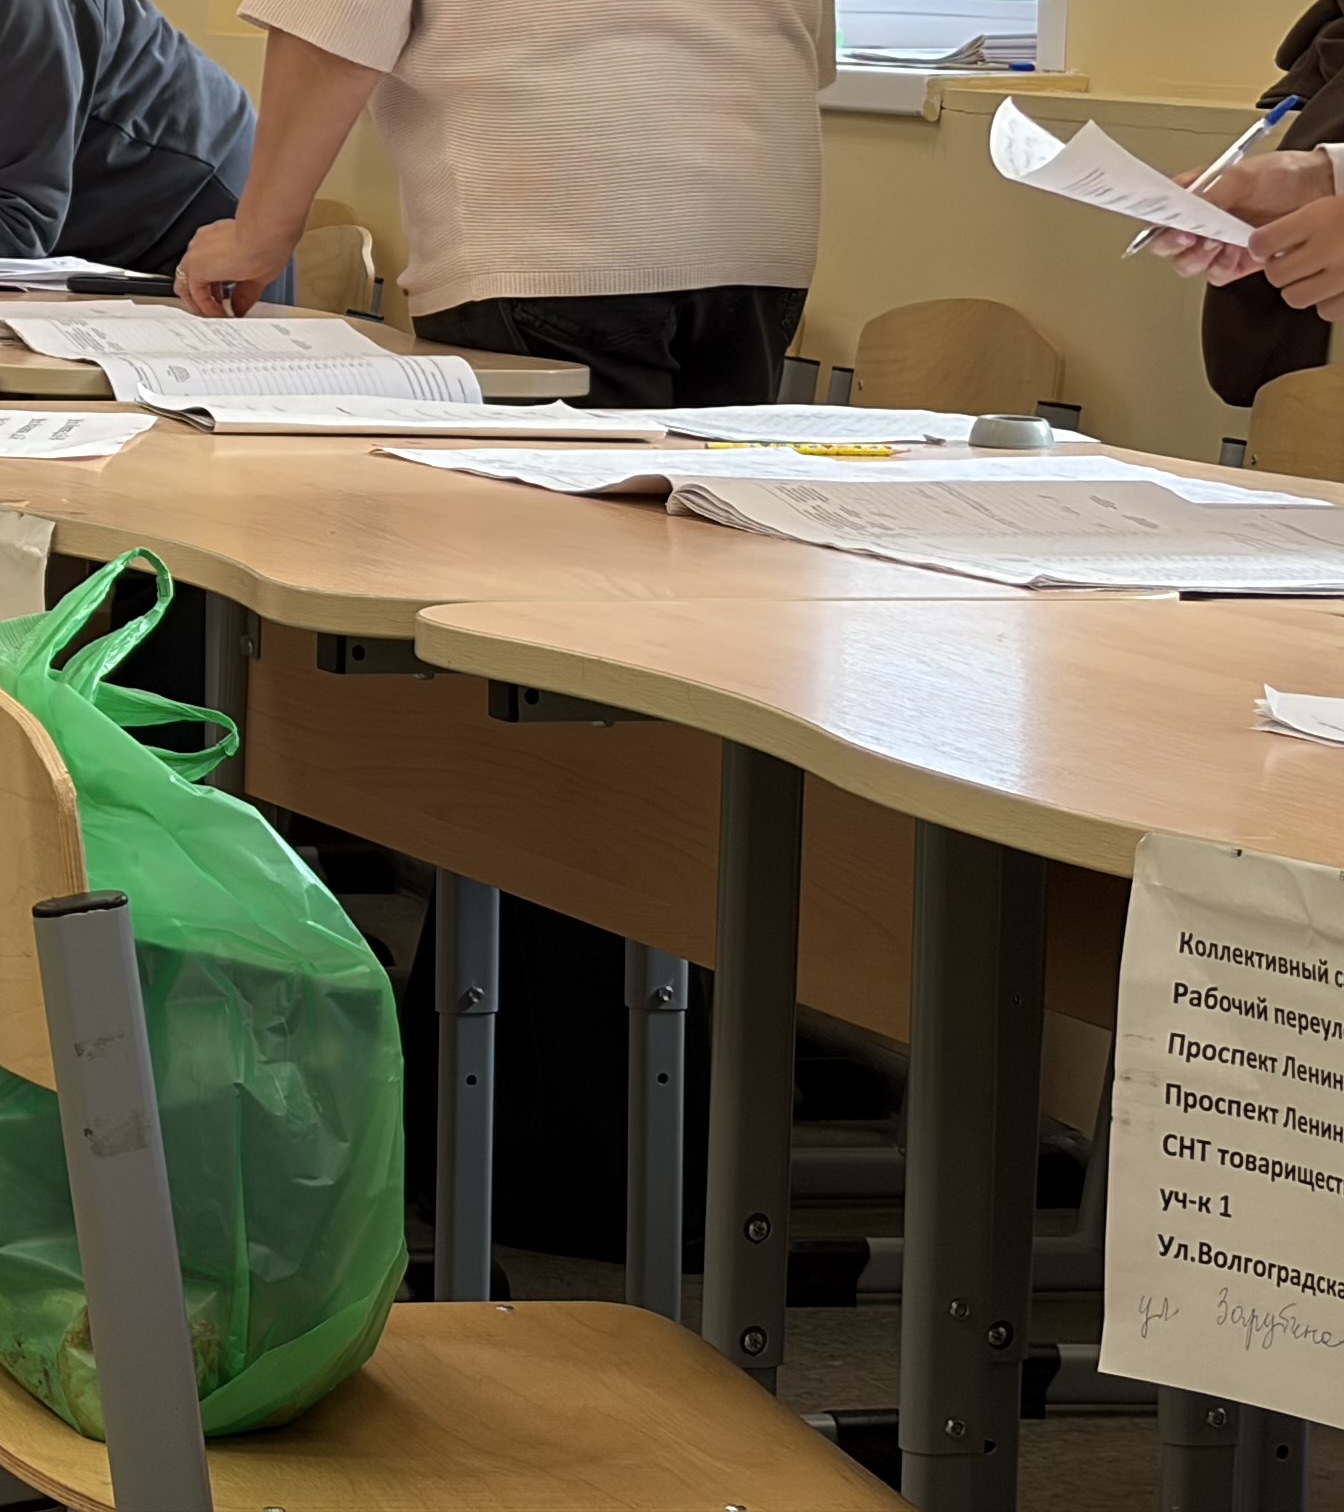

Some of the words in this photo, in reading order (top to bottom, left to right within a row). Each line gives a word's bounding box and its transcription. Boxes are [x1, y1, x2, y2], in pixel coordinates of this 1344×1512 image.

[1179, 931, 1329, 985] Коллективный
[1335, 971, 1344, 988] с
[1173, 982, 1268, 1021] Рабочий
[1274, 1007, 1344, 1041] переул
[1168, 1032, 1278, 1073] Проспект
[1282, 1056, 1344, 1091] Ленин
[1165, 1083, 1279, 1125] Проспект
[1283, 1107, 1344, 1141] Ленин
[1162, 1134, 1211, 1162] СНТ
[1160, 1189, 1212, 1214] уч-к
[1219, 1195, 1232, 1218] 1
